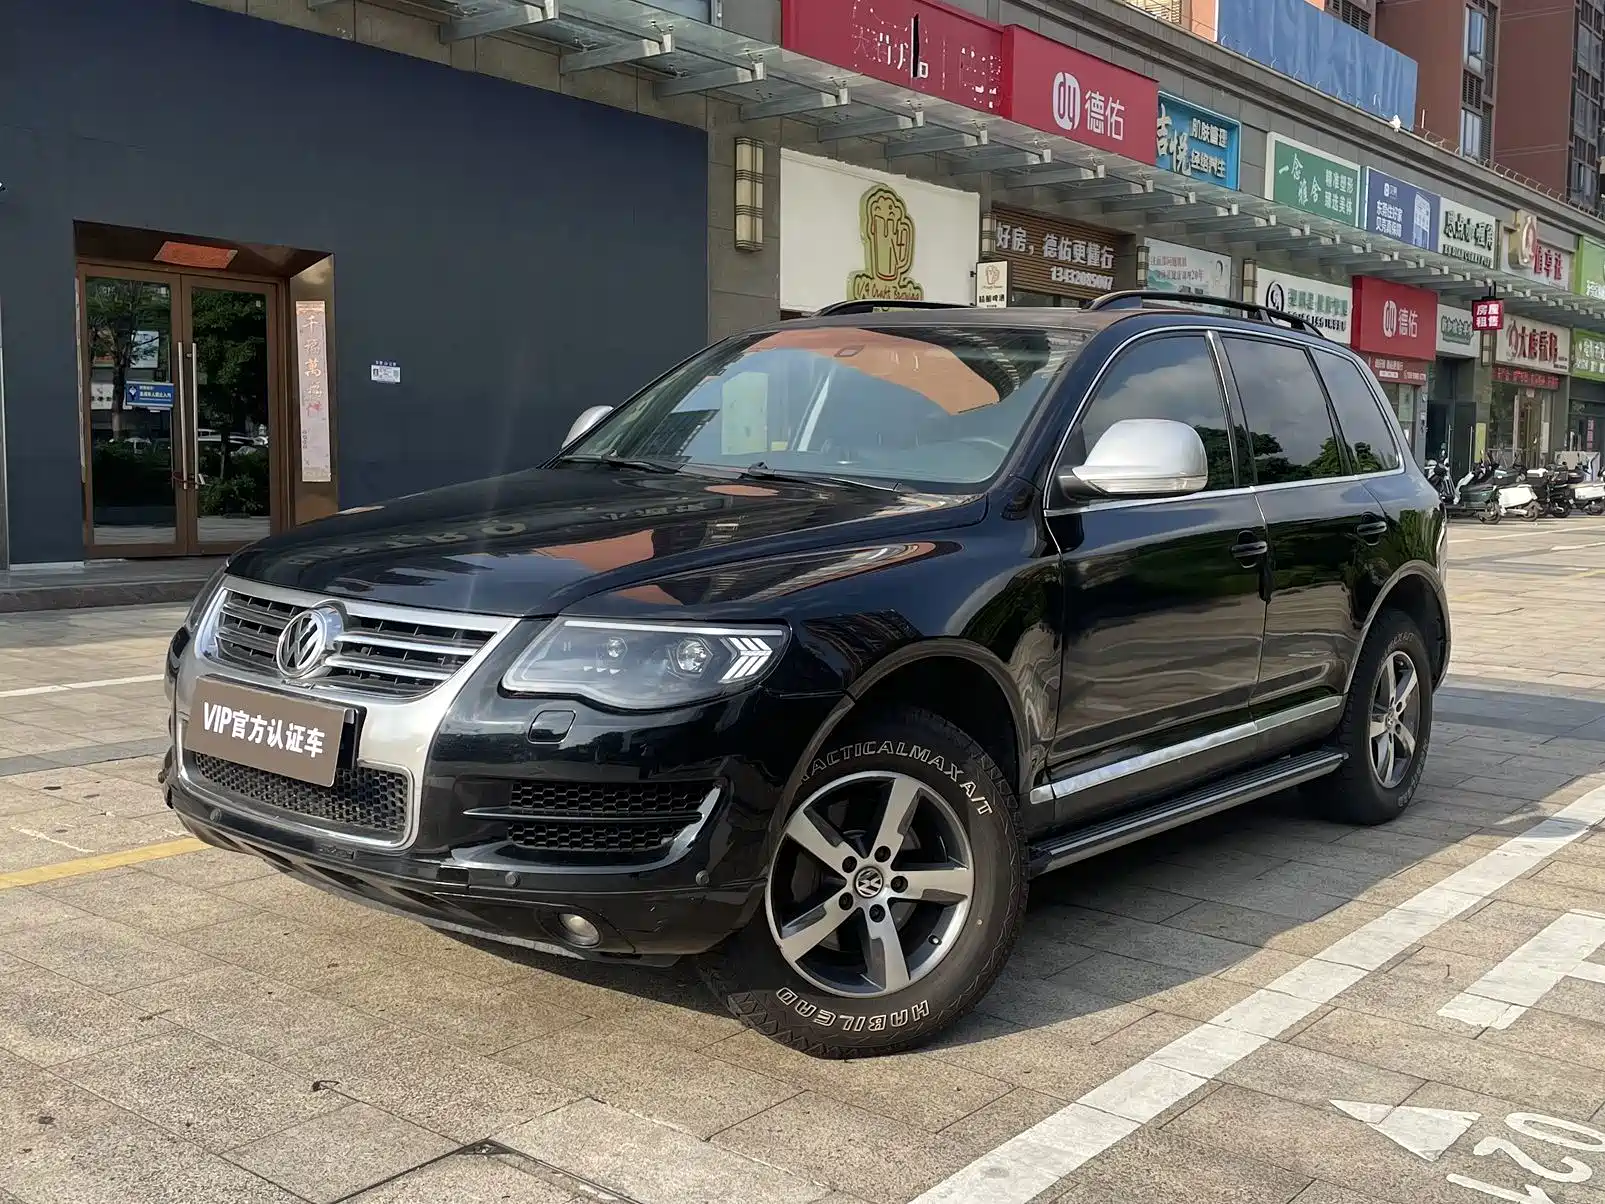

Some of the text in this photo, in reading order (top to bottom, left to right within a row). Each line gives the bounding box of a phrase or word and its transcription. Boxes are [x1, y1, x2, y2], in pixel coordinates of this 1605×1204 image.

[1084, 89, 1125, 141] 德佑
[1191, 117, 1228, 149] 肌肤管理
[1397, 306, 1419, 339] 德佑
[1476, 303, 1500, 316] 房屋
[1476, 315, 1499, 328] 租售
[203, 701, 326, 758] VIP官方认证车
[775, 986, 931, 1032] HABILEAD
